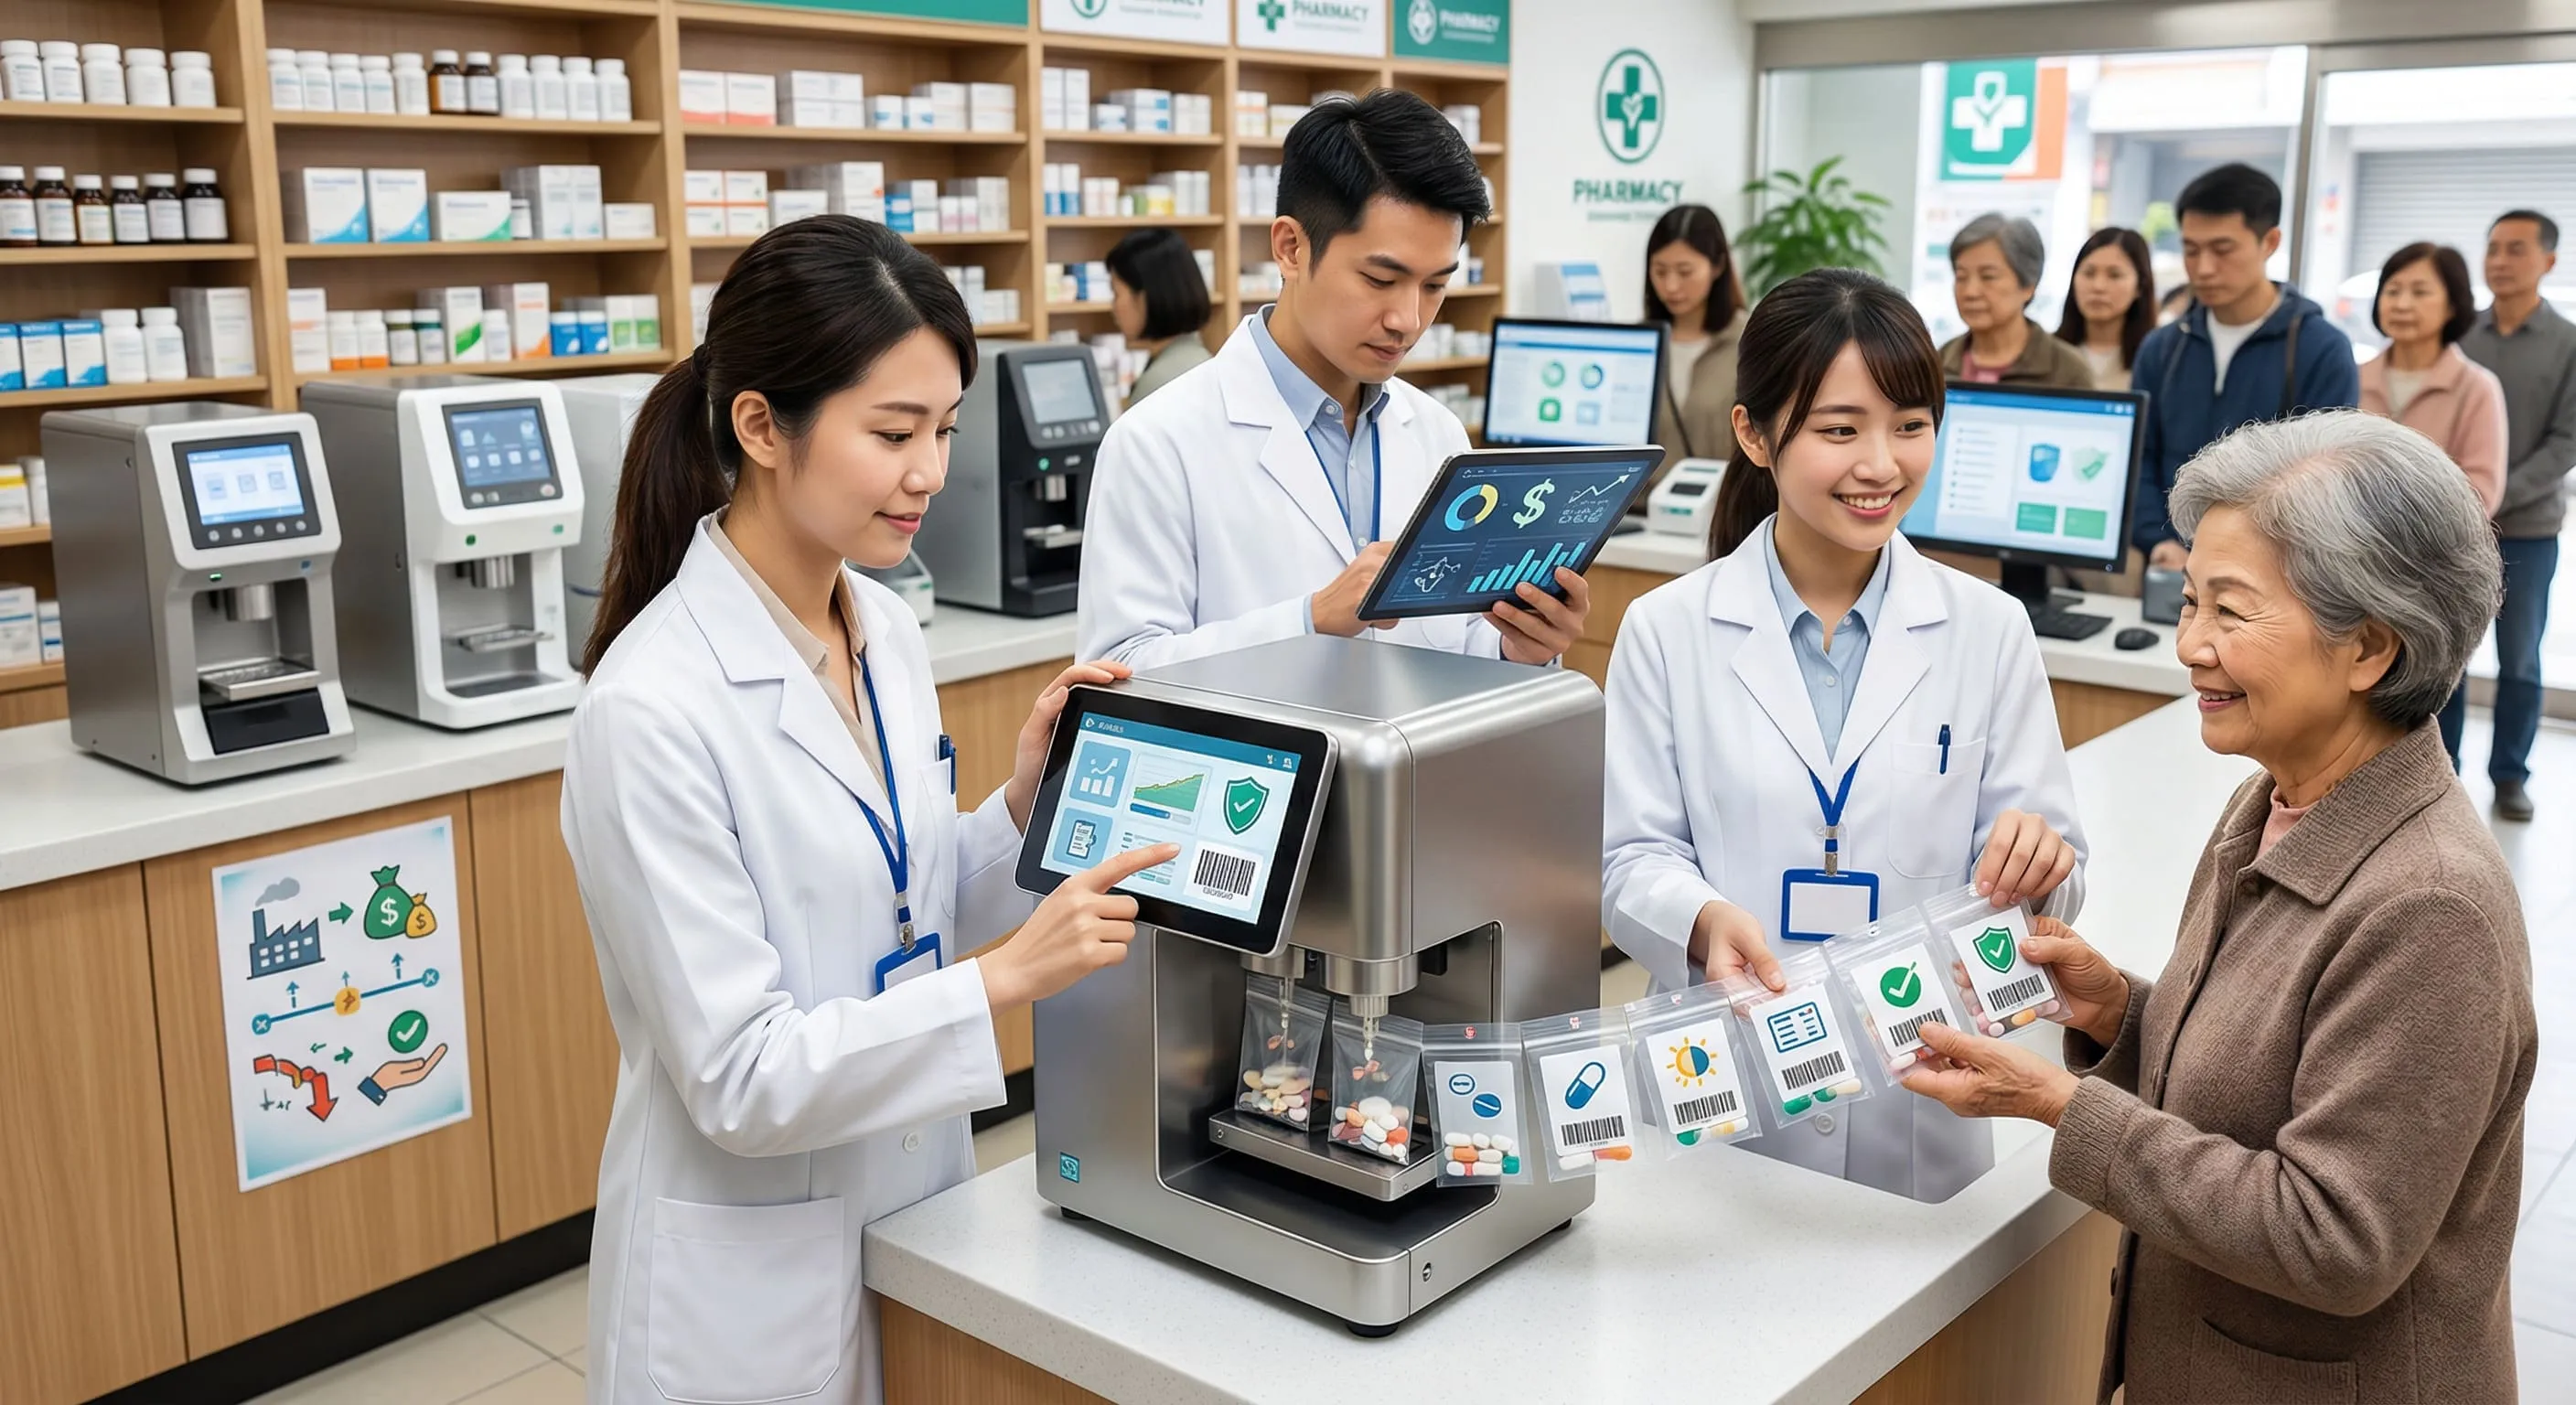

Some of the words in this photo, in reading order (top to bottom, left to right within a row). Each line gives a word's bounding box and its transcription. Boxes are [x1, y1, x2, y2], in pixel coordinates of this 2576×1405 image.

[1292, 0, 1369, 22] PHARMACY
[1439, 9, 1501, 32] PHARMACY
[1573, 179, 1683, 204] PHARMACY
